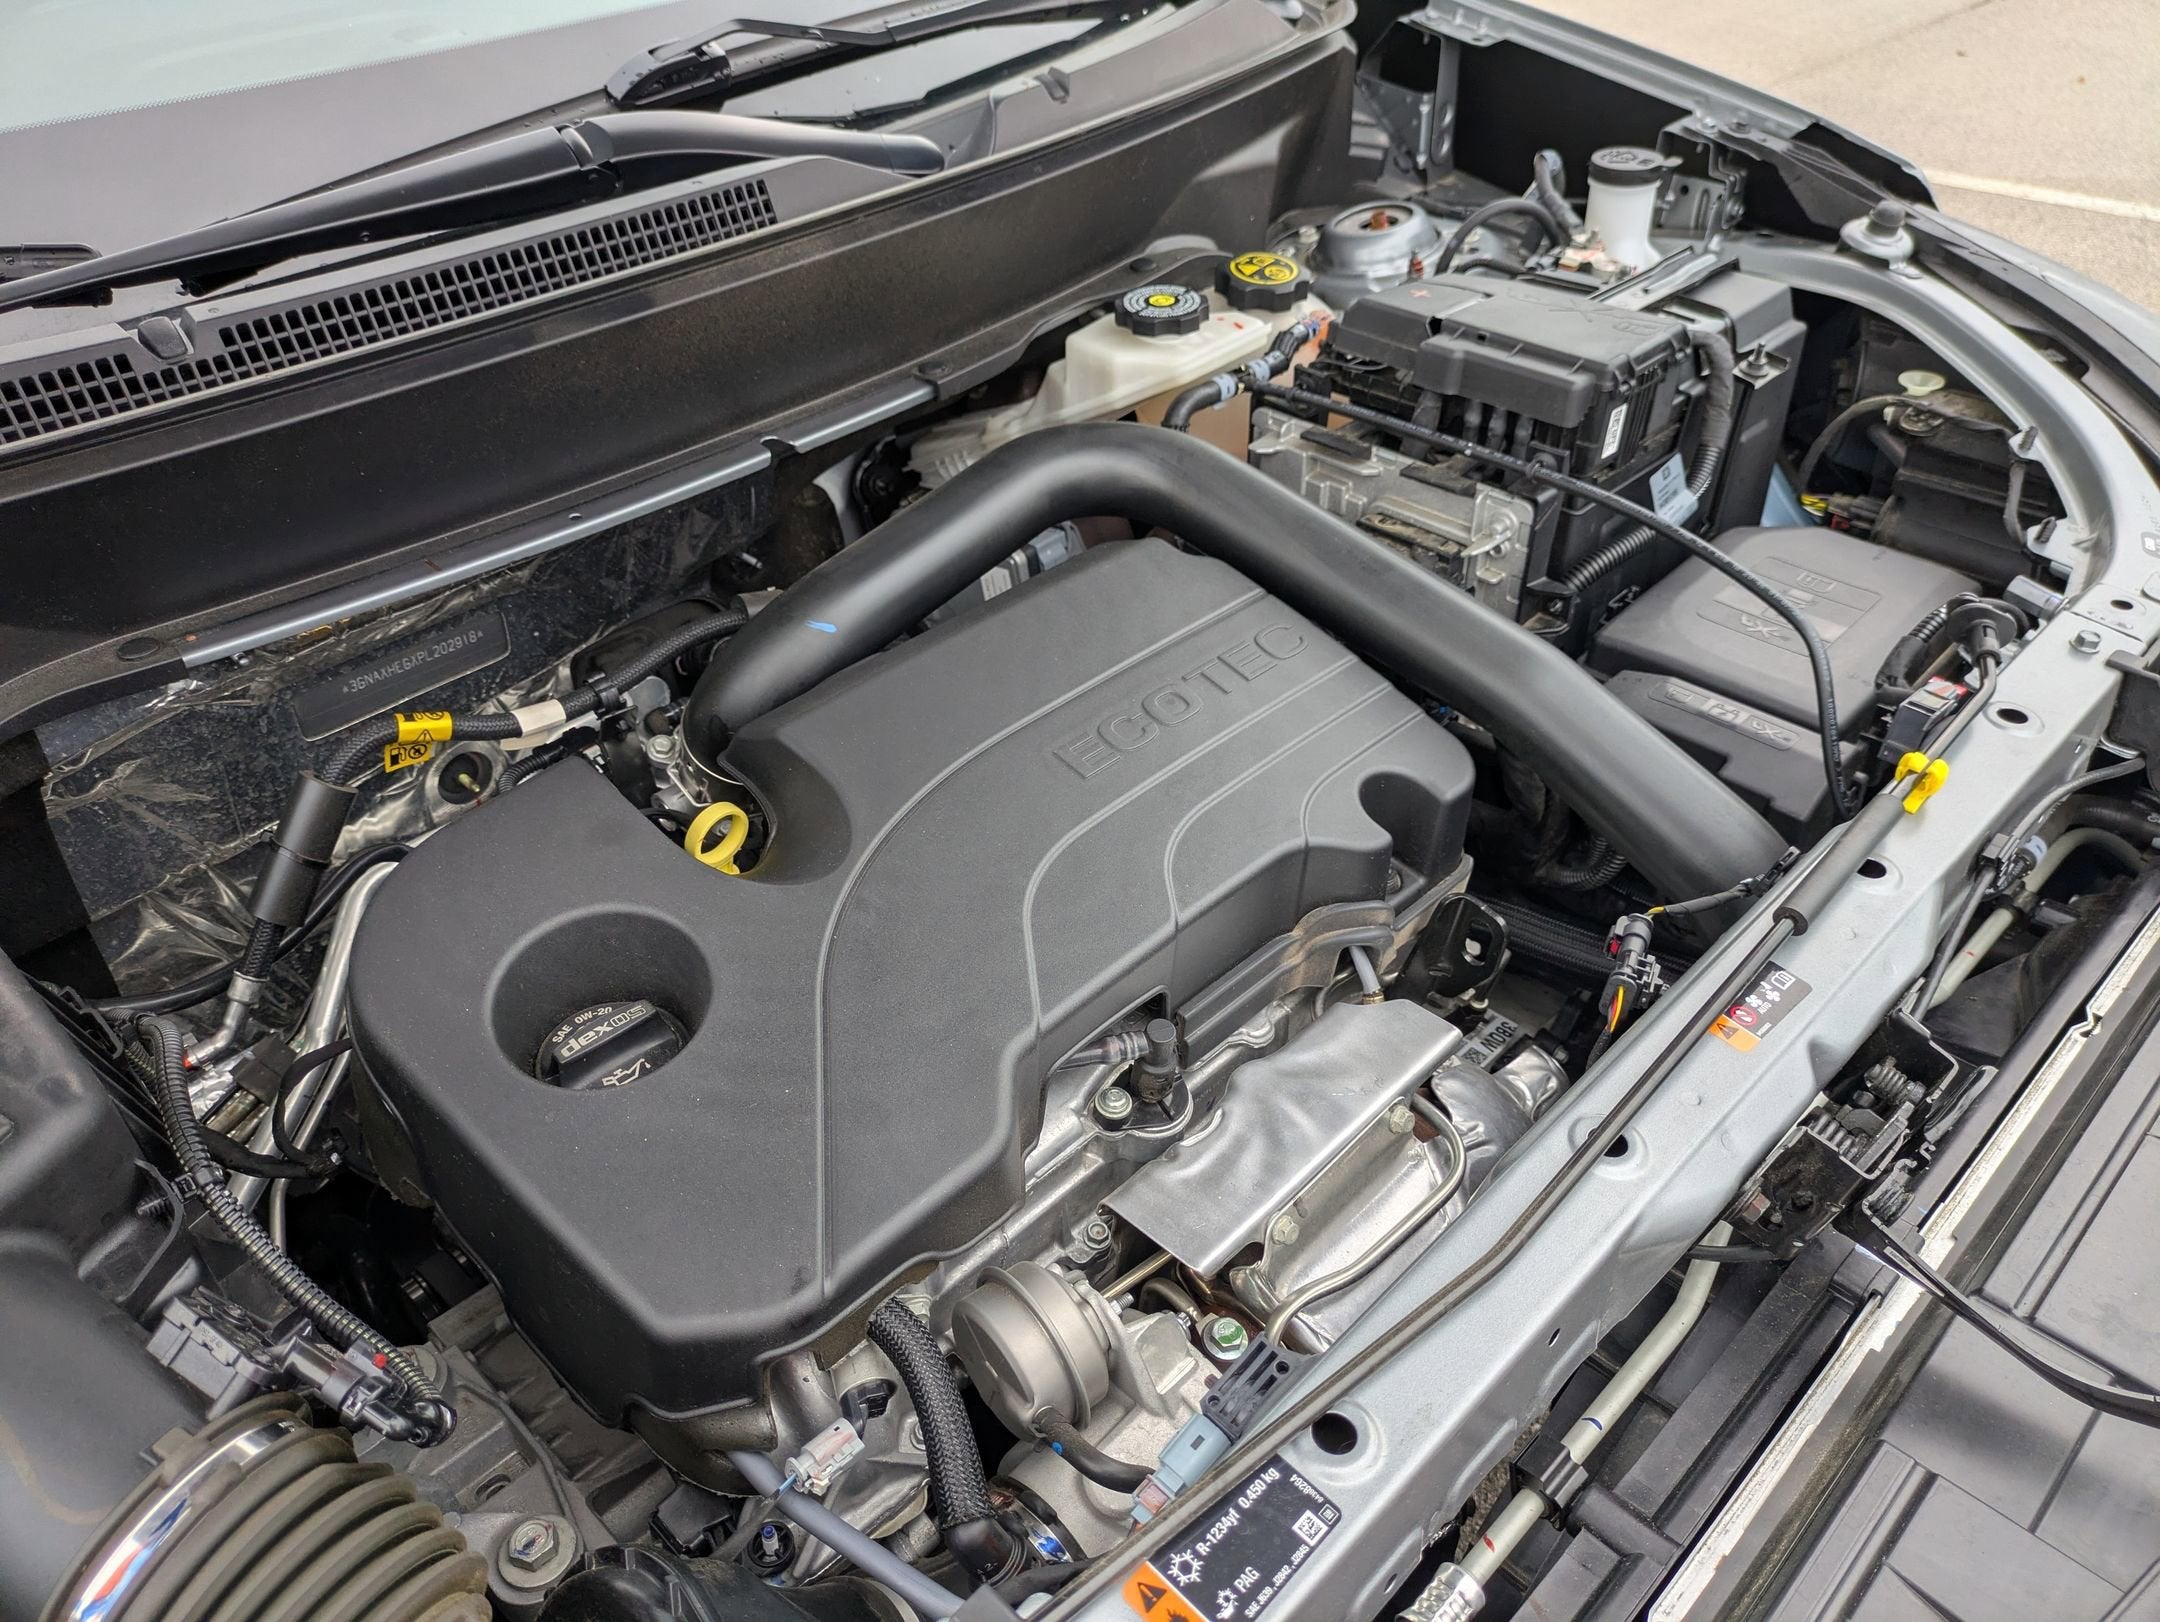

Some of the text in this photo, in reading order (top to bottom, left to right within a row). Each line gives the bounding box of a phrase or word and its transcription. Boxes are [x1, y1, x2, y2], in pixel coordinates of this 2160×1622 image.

[1052, 622, 1309, 780] ECOTEC
[552, 1006, 612, 1044] SAE 0W-20
[1195, 1467, 1280, 1556] R-1234yf 0.450 kg
[1233, 1565, 1261, 1594] PAG
[1244, 1601, 1261, 1619] SAE
